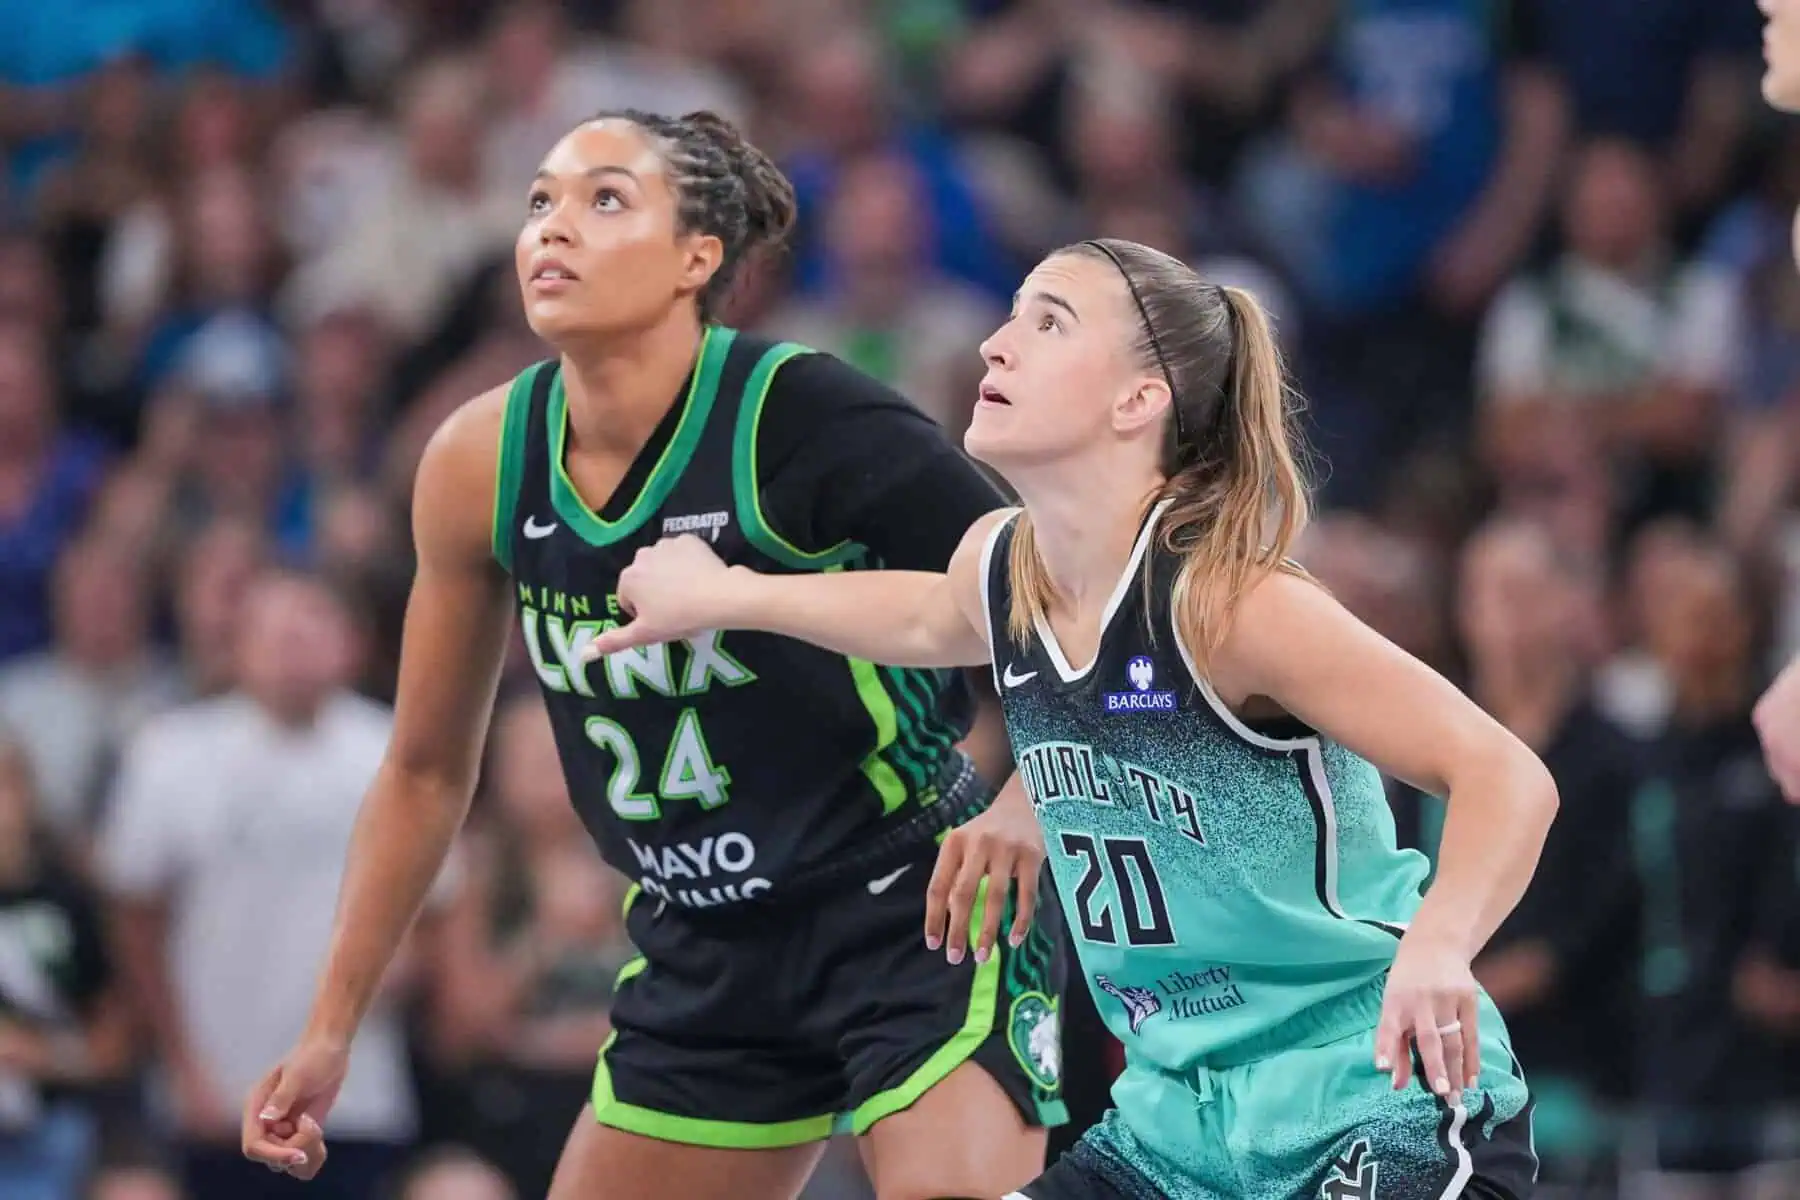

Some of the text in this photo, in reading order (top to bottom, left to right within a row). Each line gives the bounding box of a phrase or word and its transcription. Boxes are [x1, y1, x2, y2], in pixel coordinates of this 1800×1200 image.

[663, 511, 729, 543] FEDERATED
[519, 581, 619, 616] MINNE
[521, 605, 758, 699] LYNX
[1108, 694, 1173, 710] BARCLAYS
[584, 707, 732, 821] 24
[627, 832, 756, 880] MAYO
[1059, 831, 1178, 947] 20
[1156, 965, 1231, 996] Liberty
[1168, 983, 1248, 1021] Mutual
